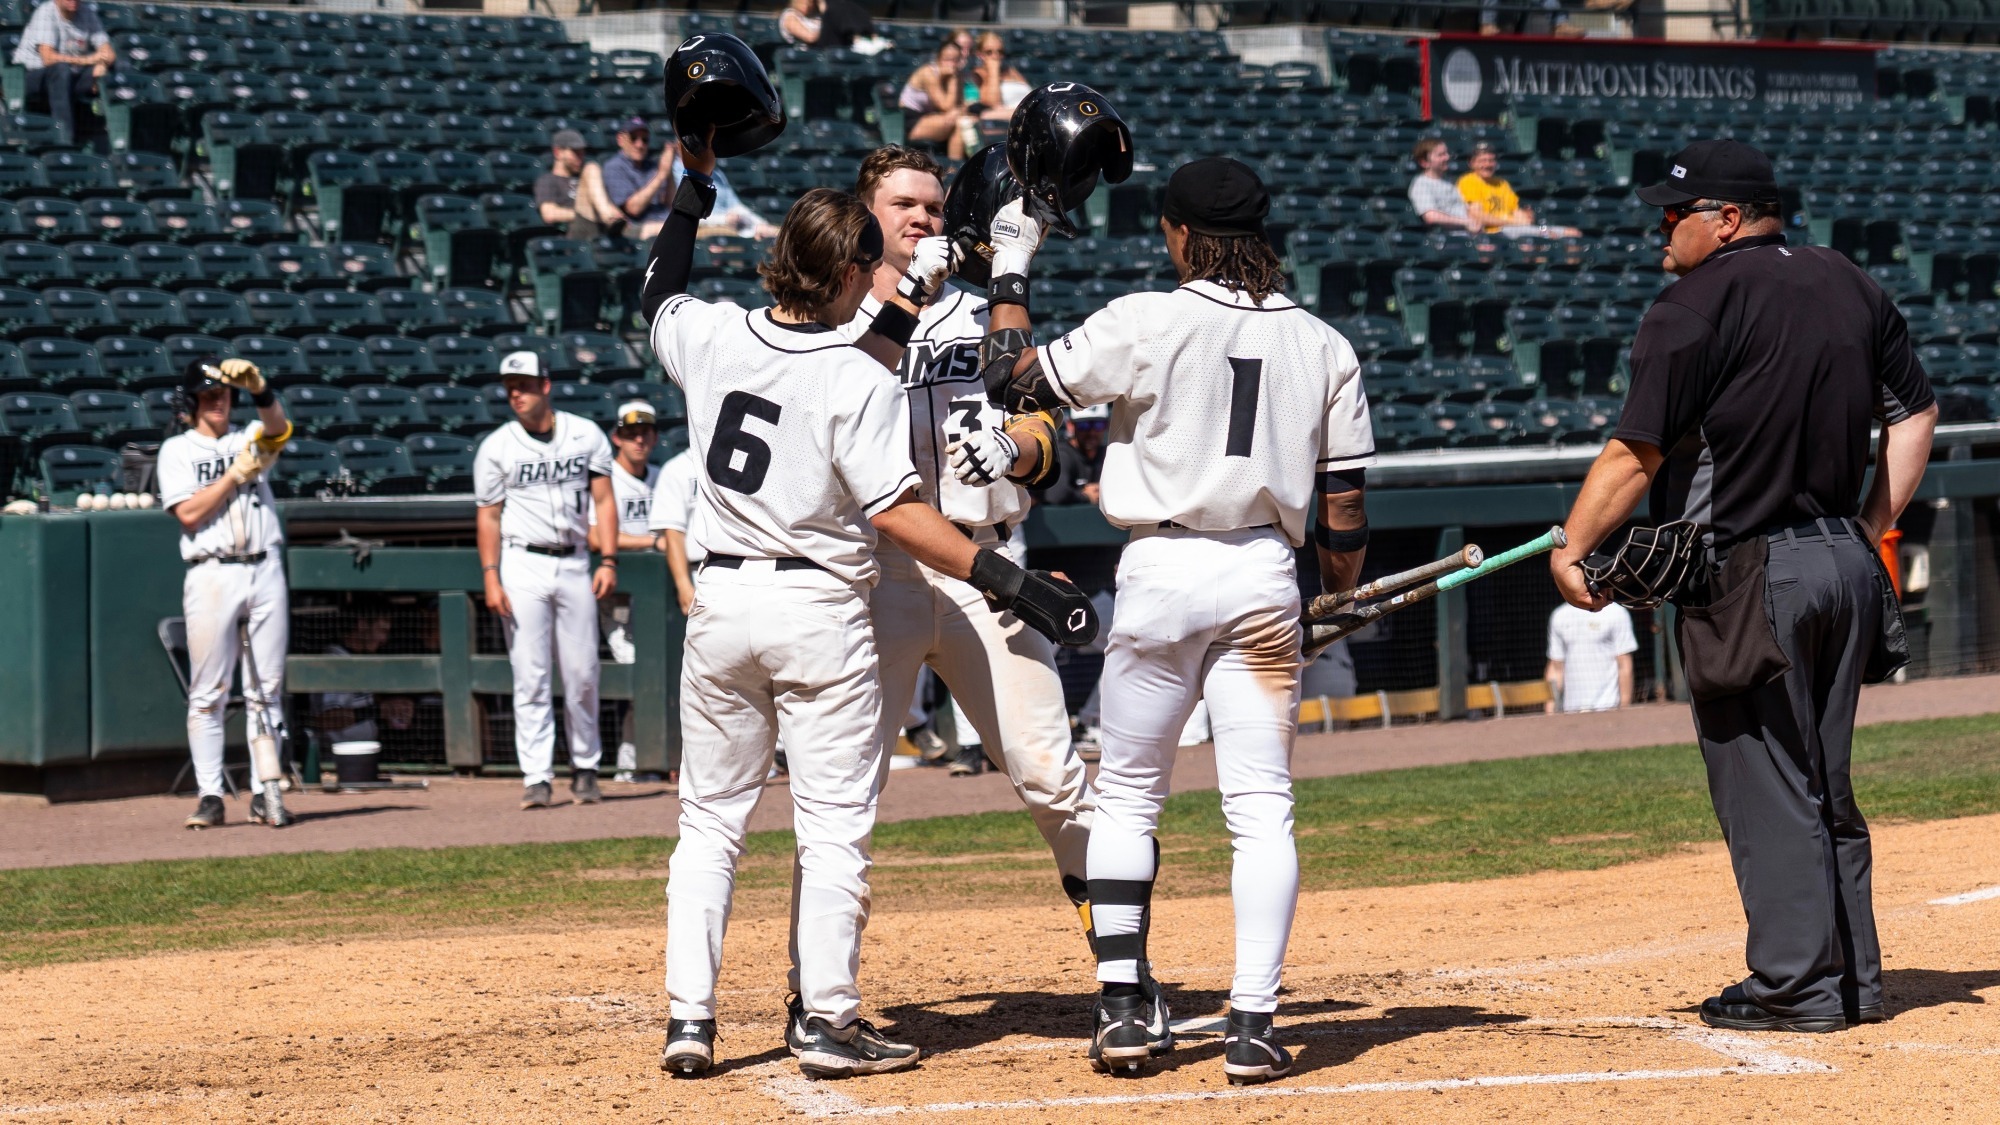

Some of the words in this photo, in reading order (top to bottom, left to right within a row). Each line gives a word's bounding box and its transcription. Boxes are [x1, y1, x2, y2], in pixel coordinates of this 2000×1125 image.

[894, 343, 981, 385] AMS
[706, 390, 782, 496] 6
[1225, 356, 1263, 458] 1
[519, 456, 584, 482] RAMS
